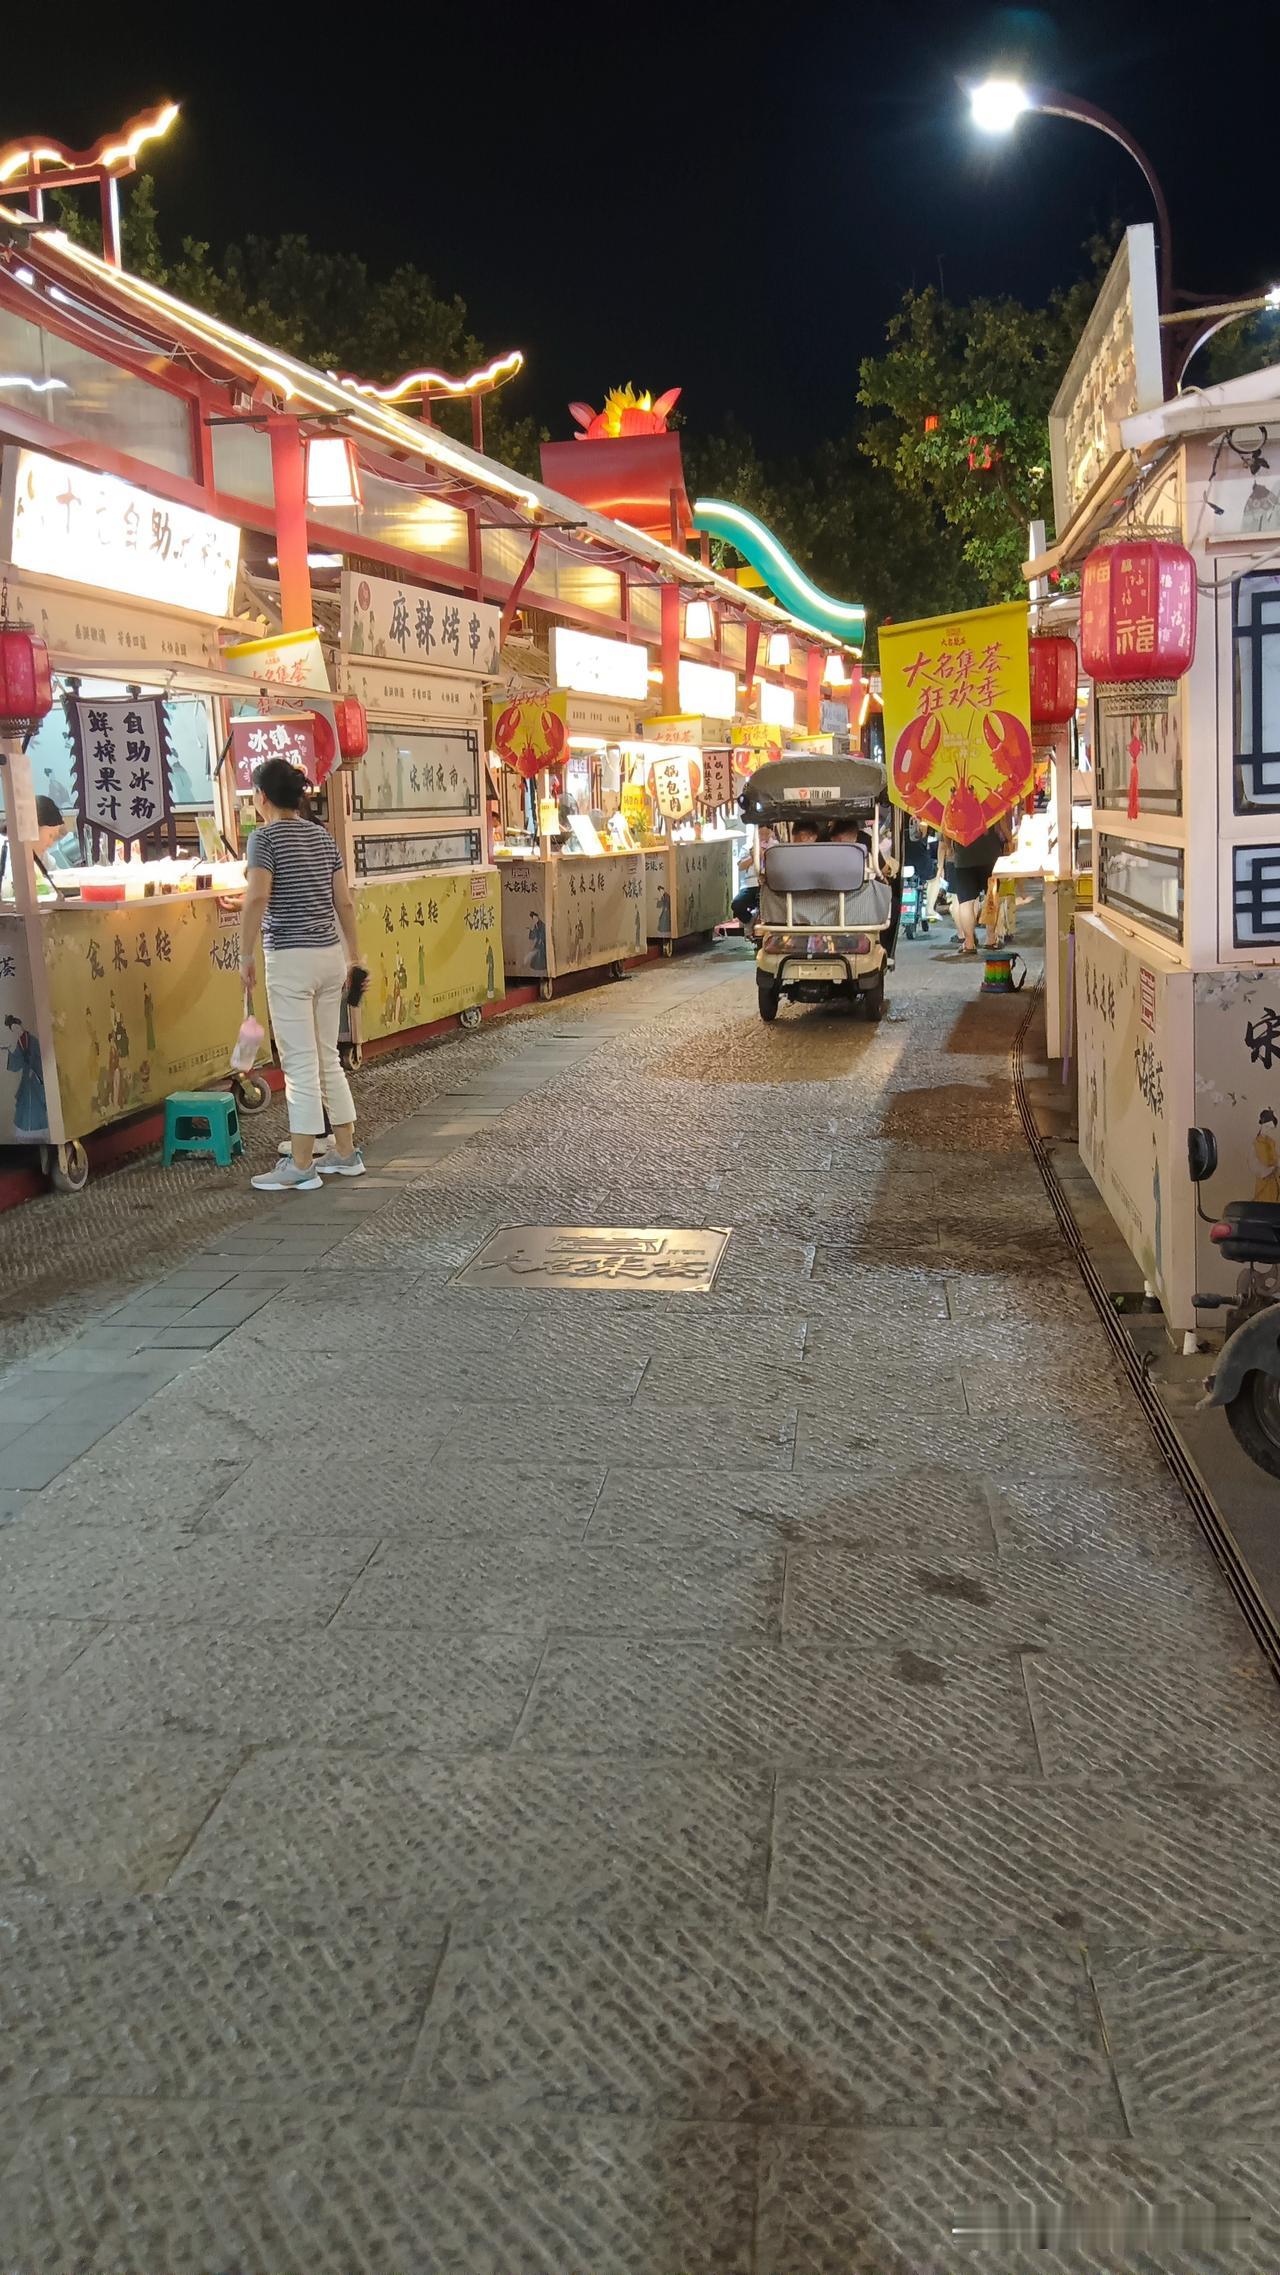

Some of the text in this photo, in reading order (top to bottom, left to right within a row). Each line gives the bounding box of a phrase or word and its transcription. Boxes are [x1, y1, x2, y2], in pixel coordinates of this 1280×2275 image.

[389, 590, 481, 664] 麻辣烤串
[1116, 616, 1155, 656] 福
[902, 641, 1011, 688] 大名集荟
[917, 675, 1012, 715] 狂欢季
[248, 724, 292, 753] 冰镇
[87, 709, 122, 821] 鲜榨果汁
[123, 711, 156, 820] 自助冰粉
[249, 749, 303, 772] 酸汤
[504, 880, 538, 894] 大名集荟
[382, 897, 439, 934] 食来运转
[464, 903, 495, 931] 大名集荟
[86, 927, 172, 980] 食来运转
[210, 932, 241, 970] 大名集
